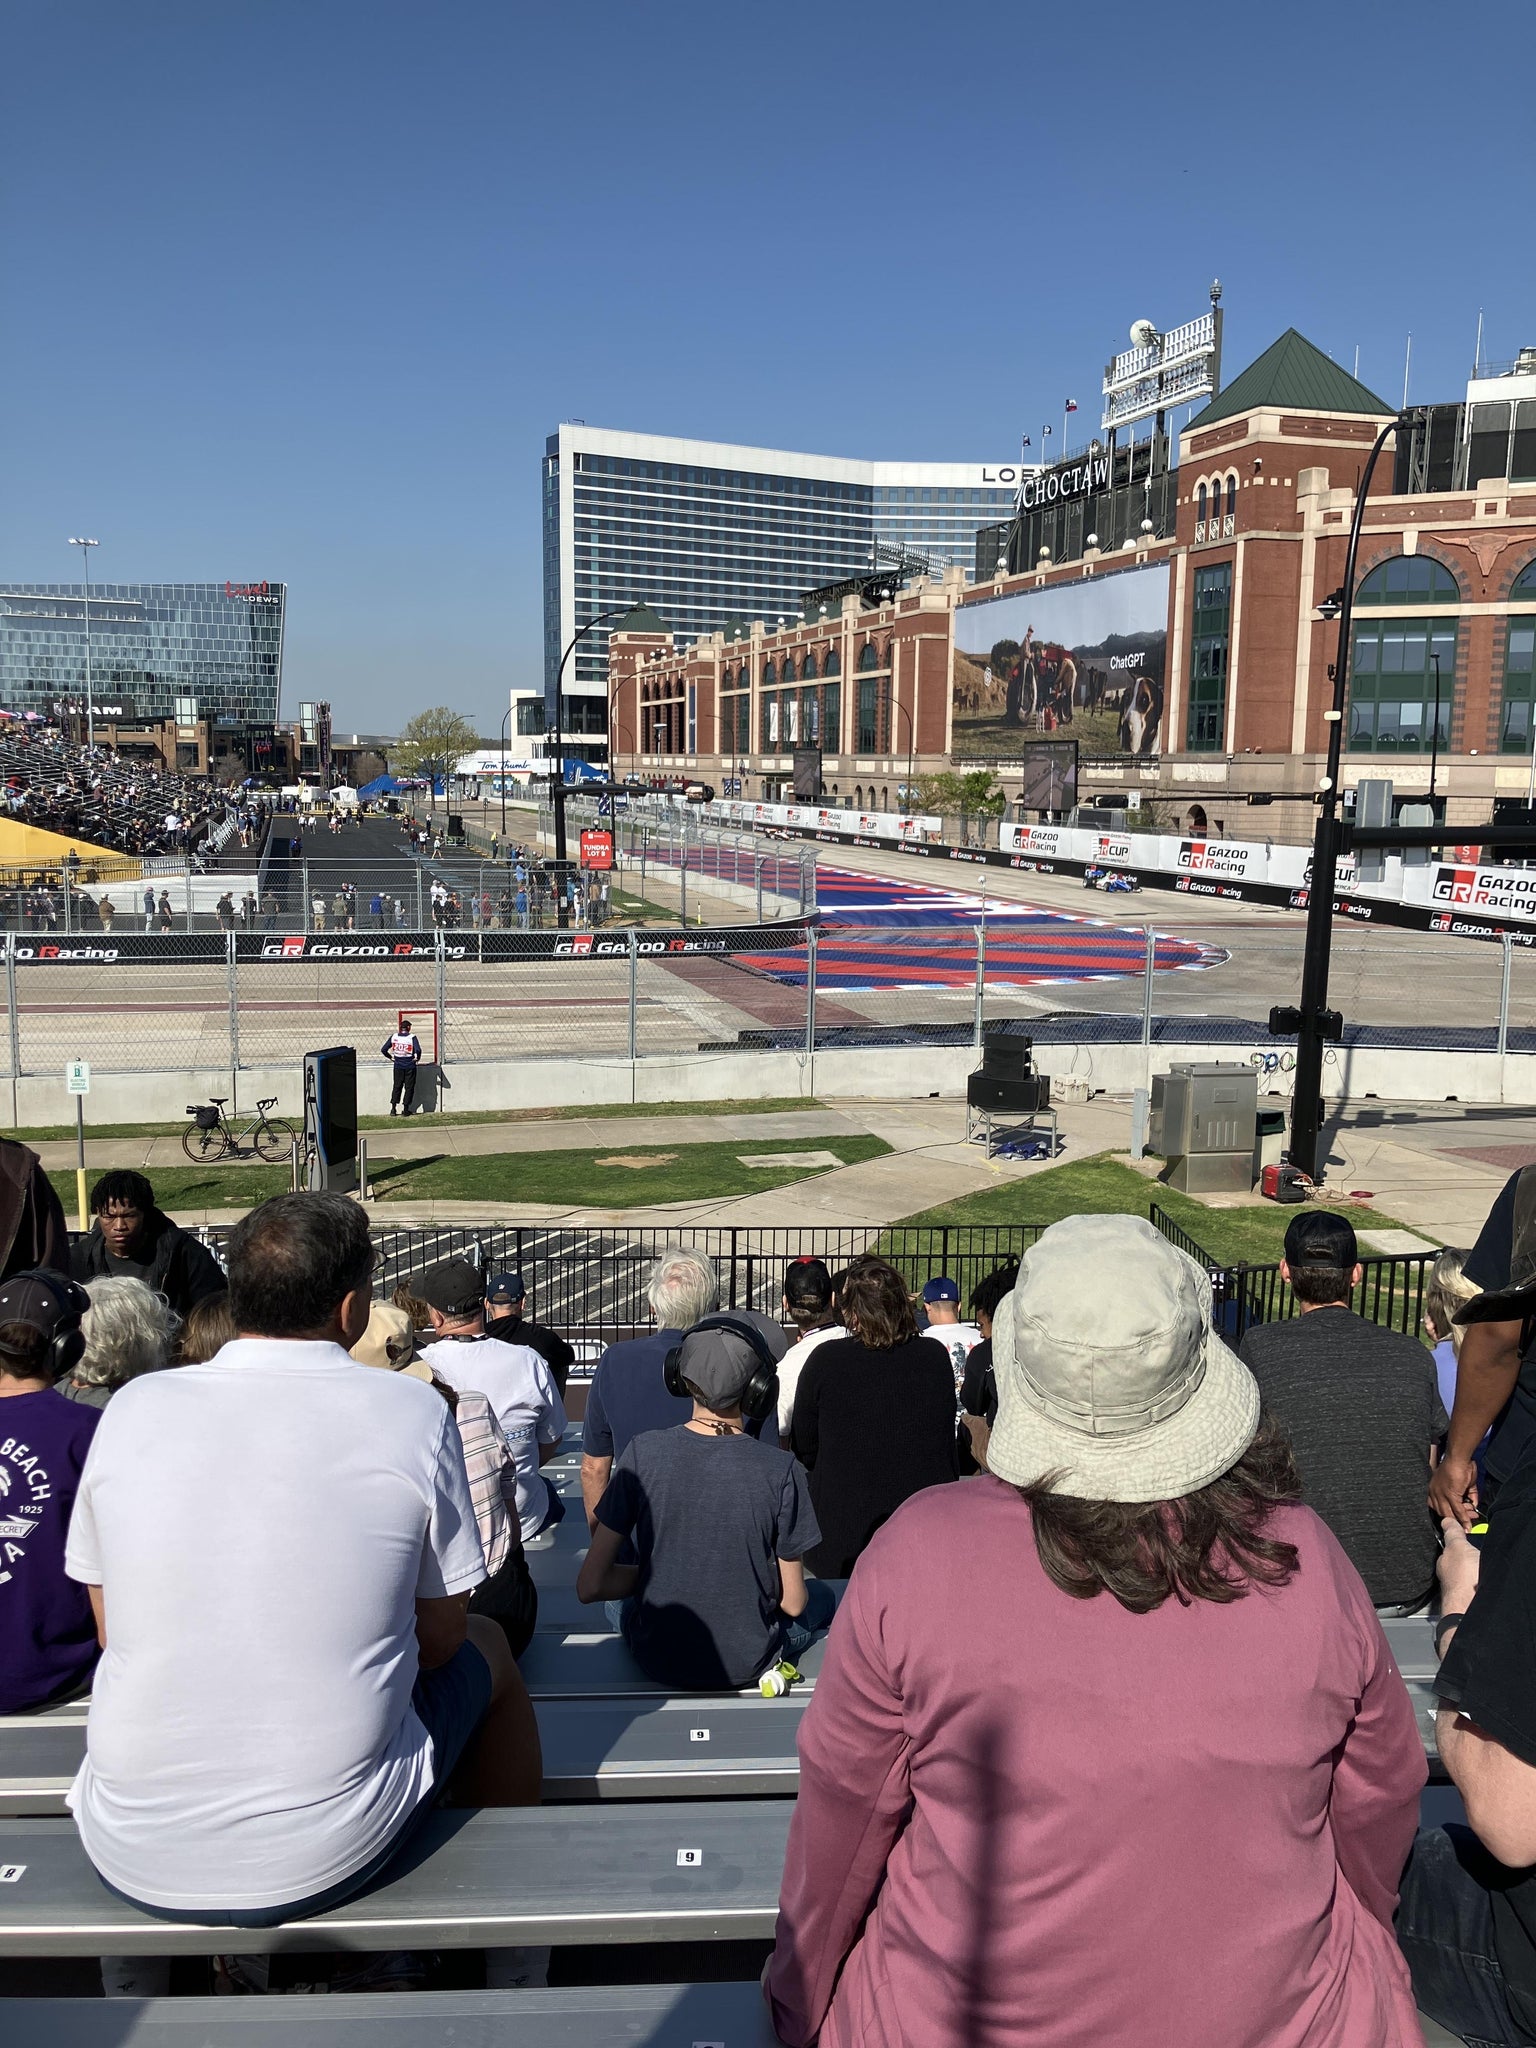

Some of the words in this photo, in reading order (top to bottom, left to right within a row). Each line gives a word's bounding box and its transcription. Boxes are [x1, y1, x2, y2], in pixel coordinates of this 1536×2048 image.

[983, 468, 1046, 482] LOE
[243, 596, 279, 604] LOEWS
[1110, 652, 1146, 670] ChatGPT
[478, 761, 498, 771] Tom
[498, 760, 532, 771] Thumb
[1013, 835, 1029, 849] GR
[1031, 831, 1059, 841] GAZOO
[1030, 841, 1057, 854] Racing
[1109, 846, 1129, 857] CUP
[1208, 846, 1249, 859] GAZOO
[1179, 851, 1204, 869] GR
[1037, 863, 1054, 873] Racing
[1205, 858, 1246, 876] Racing
[1190, 883, 1216, 893] GAZOO
[1217, 887, 1242, 899] Racing
[1434, 880, 1472, 903] GR
[1290, 896, 1307, 907] GR
[1341, 902, 1372, 917] Racing
[1475, 891, 1536, 915] Racing
[1431, 919, 1450, 931] GR
[263, 945, 303, 957] GR
[310, 944, 389, 956] GAZOO
[556, 943, 590, 954] GR
[597, 942, 666, 954] GAOO
[669, 939, 726, 952] Racing
[39, 945, 118, 963] Racing
[394, 1044, 409, 1052] 202
[0, 1437, 52, 1501] BEACH
[19, 1505, 43, 1514] 1925
[0, 1522, 24, 1534] ECRET
[697, 1731, 704, 1739] 9
[685, 1852, 694, 1862] 9
[4, 1869, 16, 1878] 8
